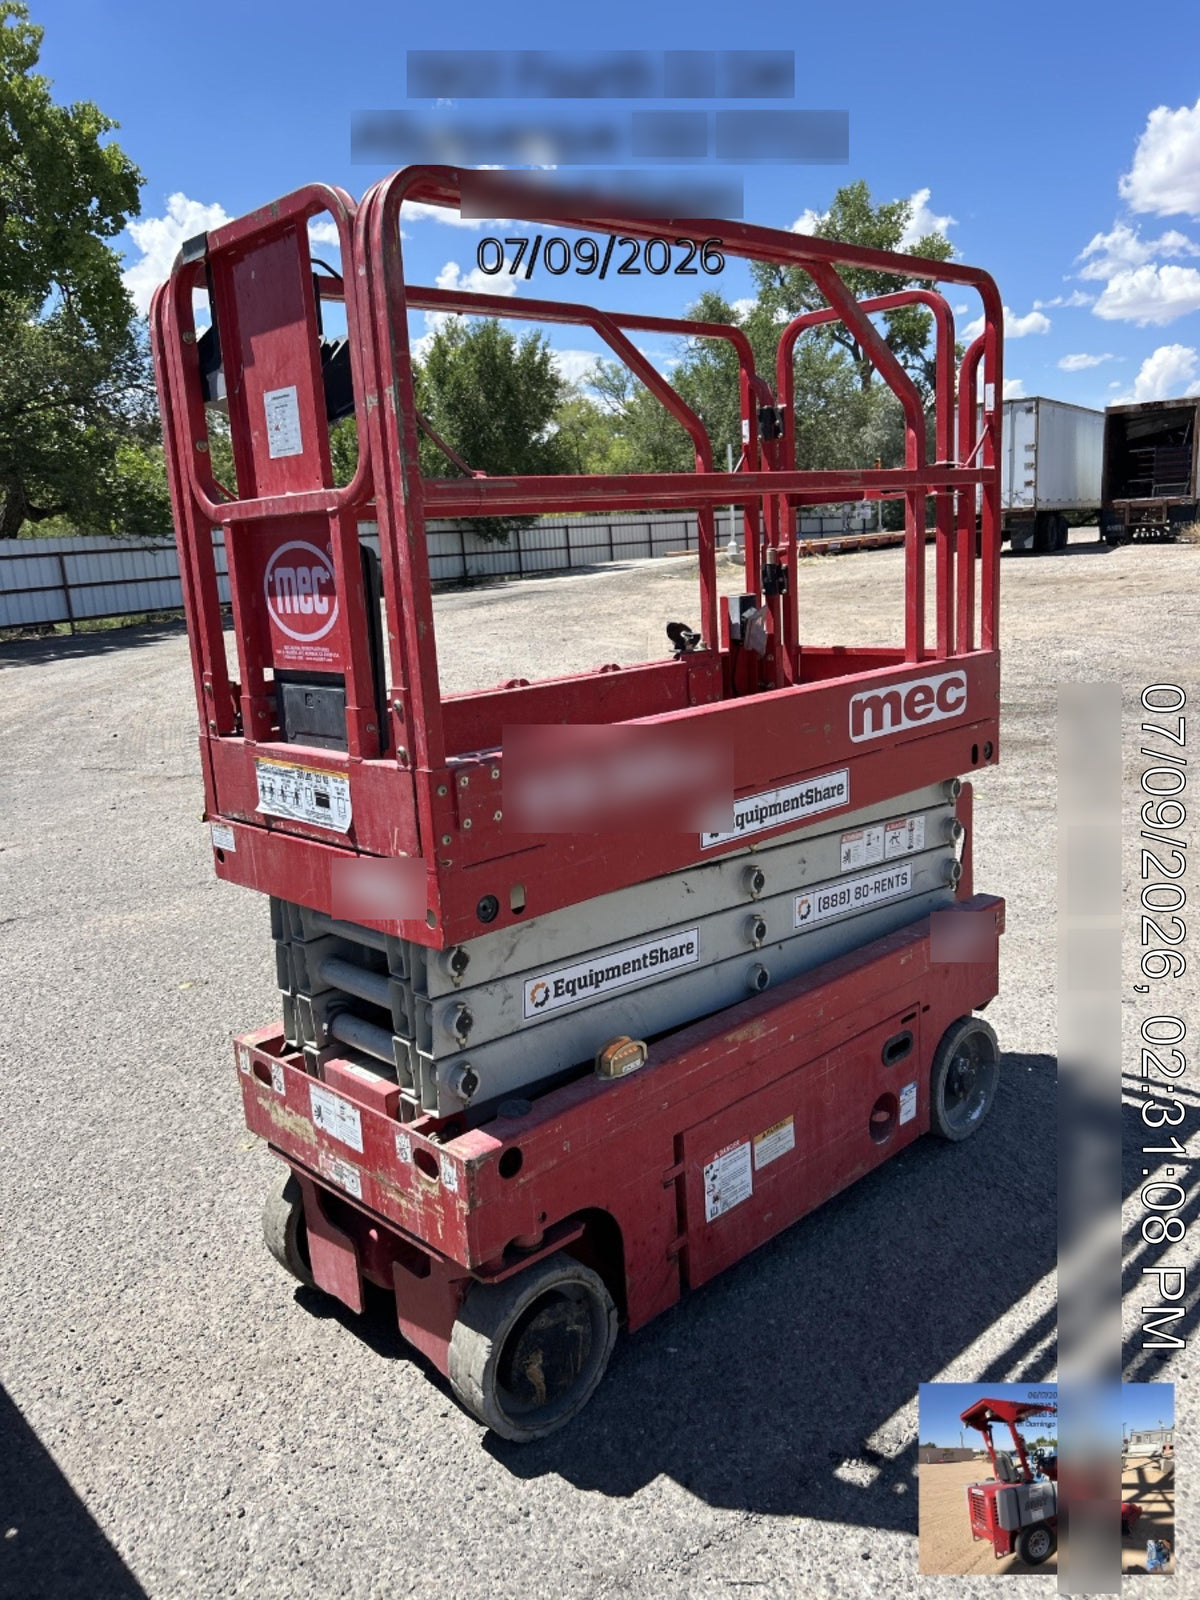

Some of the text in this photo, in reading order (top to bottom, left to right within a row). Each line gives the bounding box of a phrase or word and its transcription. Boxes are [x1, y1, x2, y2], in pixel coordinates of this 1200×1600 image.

[851, 677, 966, 738] mec
[733, 783, 844, 830] quipmentShare
[854, 872, 908, 901] 80-RENTS
[553, 941, 695, 998] EquipmentShare
